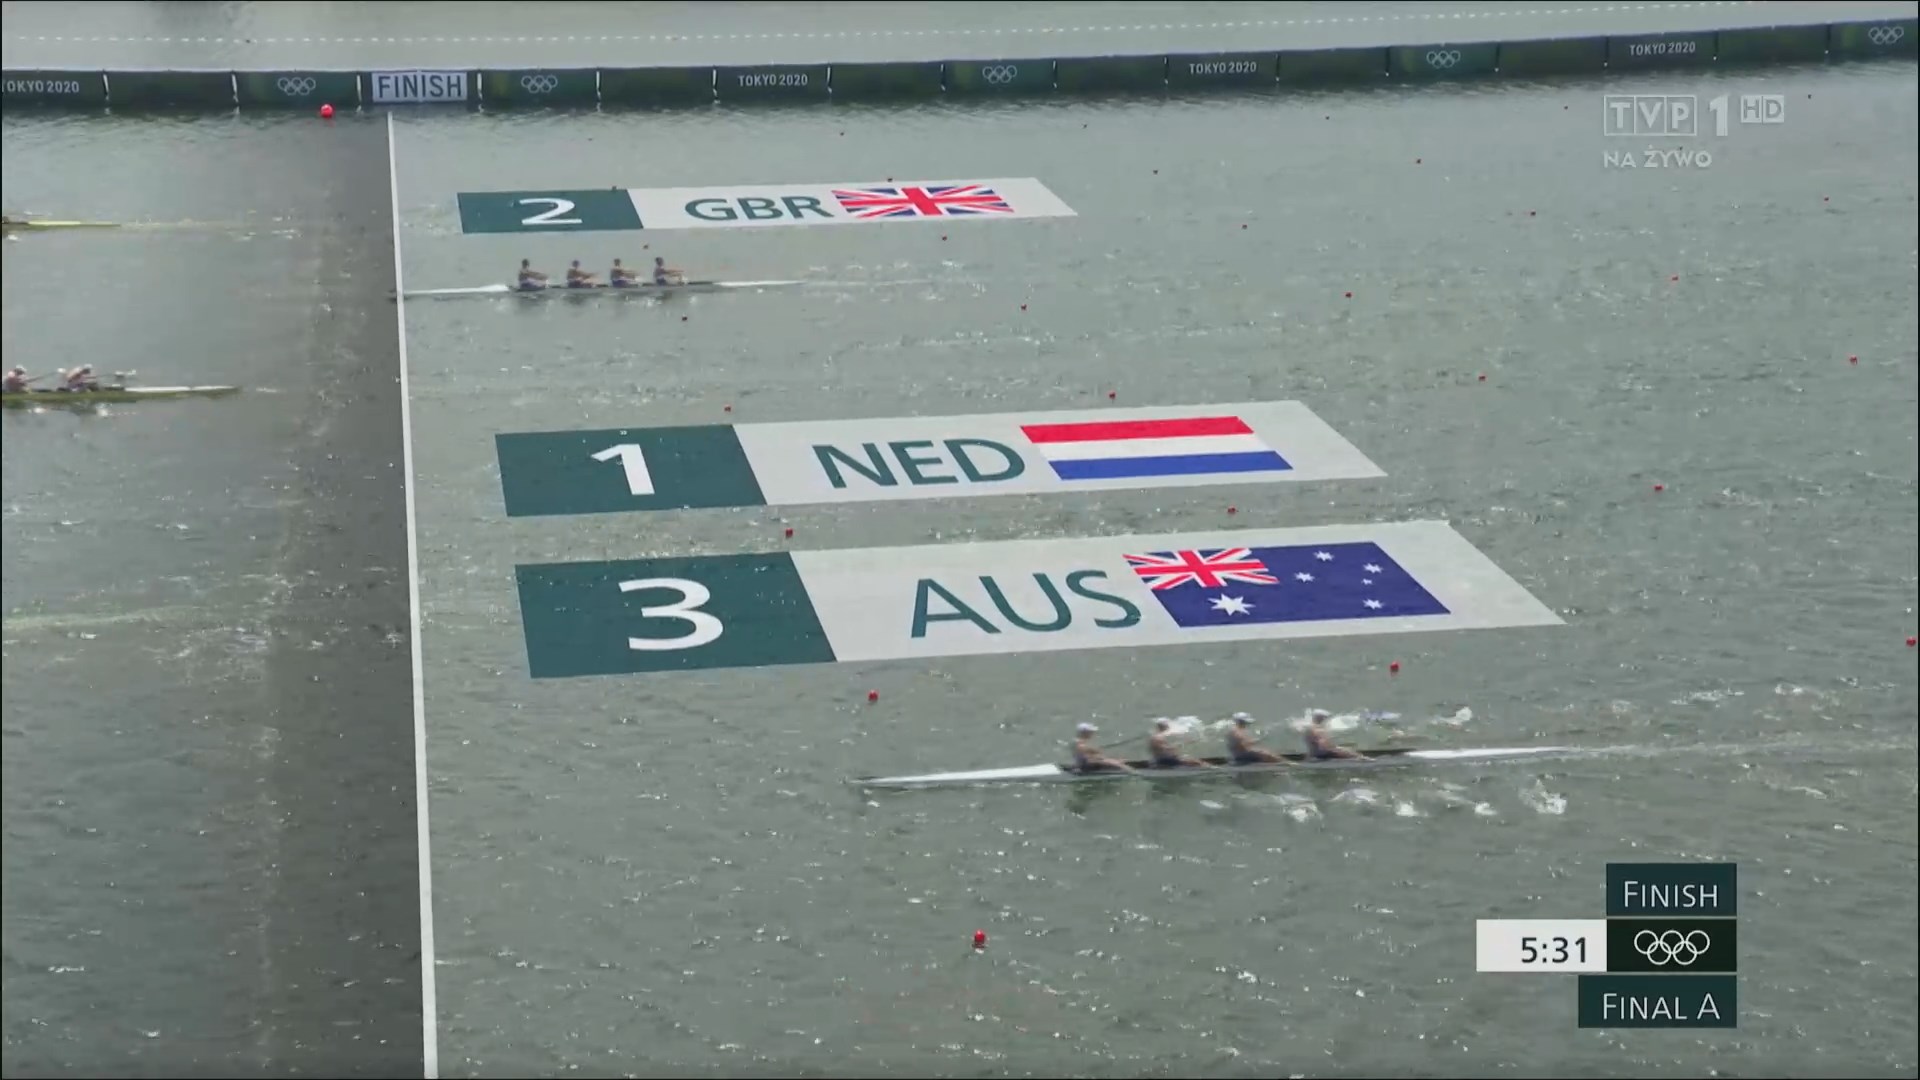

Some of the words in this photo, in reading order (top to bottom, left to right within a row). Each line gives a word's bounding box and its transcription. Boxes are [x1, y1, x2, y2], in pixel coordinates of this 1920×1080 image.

[1629, 44, 1666, 56] TOKYO
[1667, 42, 1696, 54] 2020
[1189, 62, 1226, 74] TOKYO
[1228, 61, 1257, 73] 2020
[47, 81, 80, 93] 2020
[378, 75, 462, 98] FINISH
[738, 74, 777, 87] TOKYO
[779, 73, 808, 86] 2020
